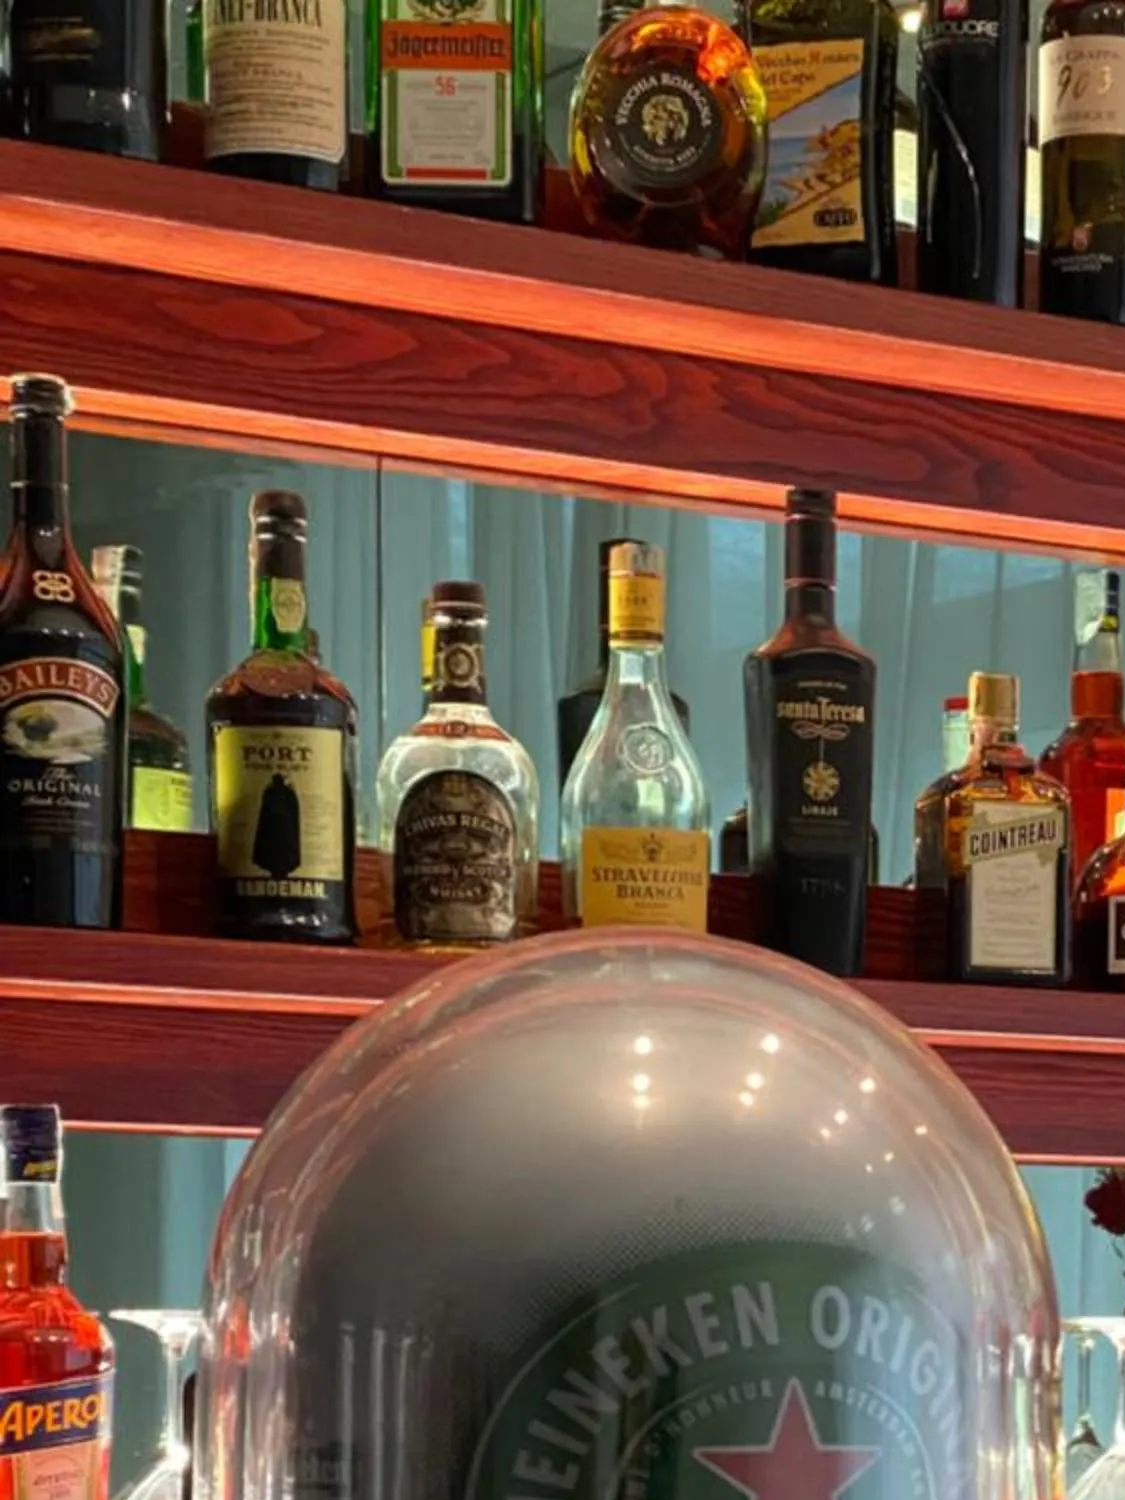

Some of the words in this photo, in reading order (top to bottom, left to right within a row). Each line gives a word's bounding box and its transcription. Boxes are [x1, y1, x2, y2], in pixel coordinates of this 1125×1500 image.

[241, 745, 313, 763] PORT
[7, 778, 102, 798] ORIGINAL
[969, 817, 1057, 857] COINTREAU
